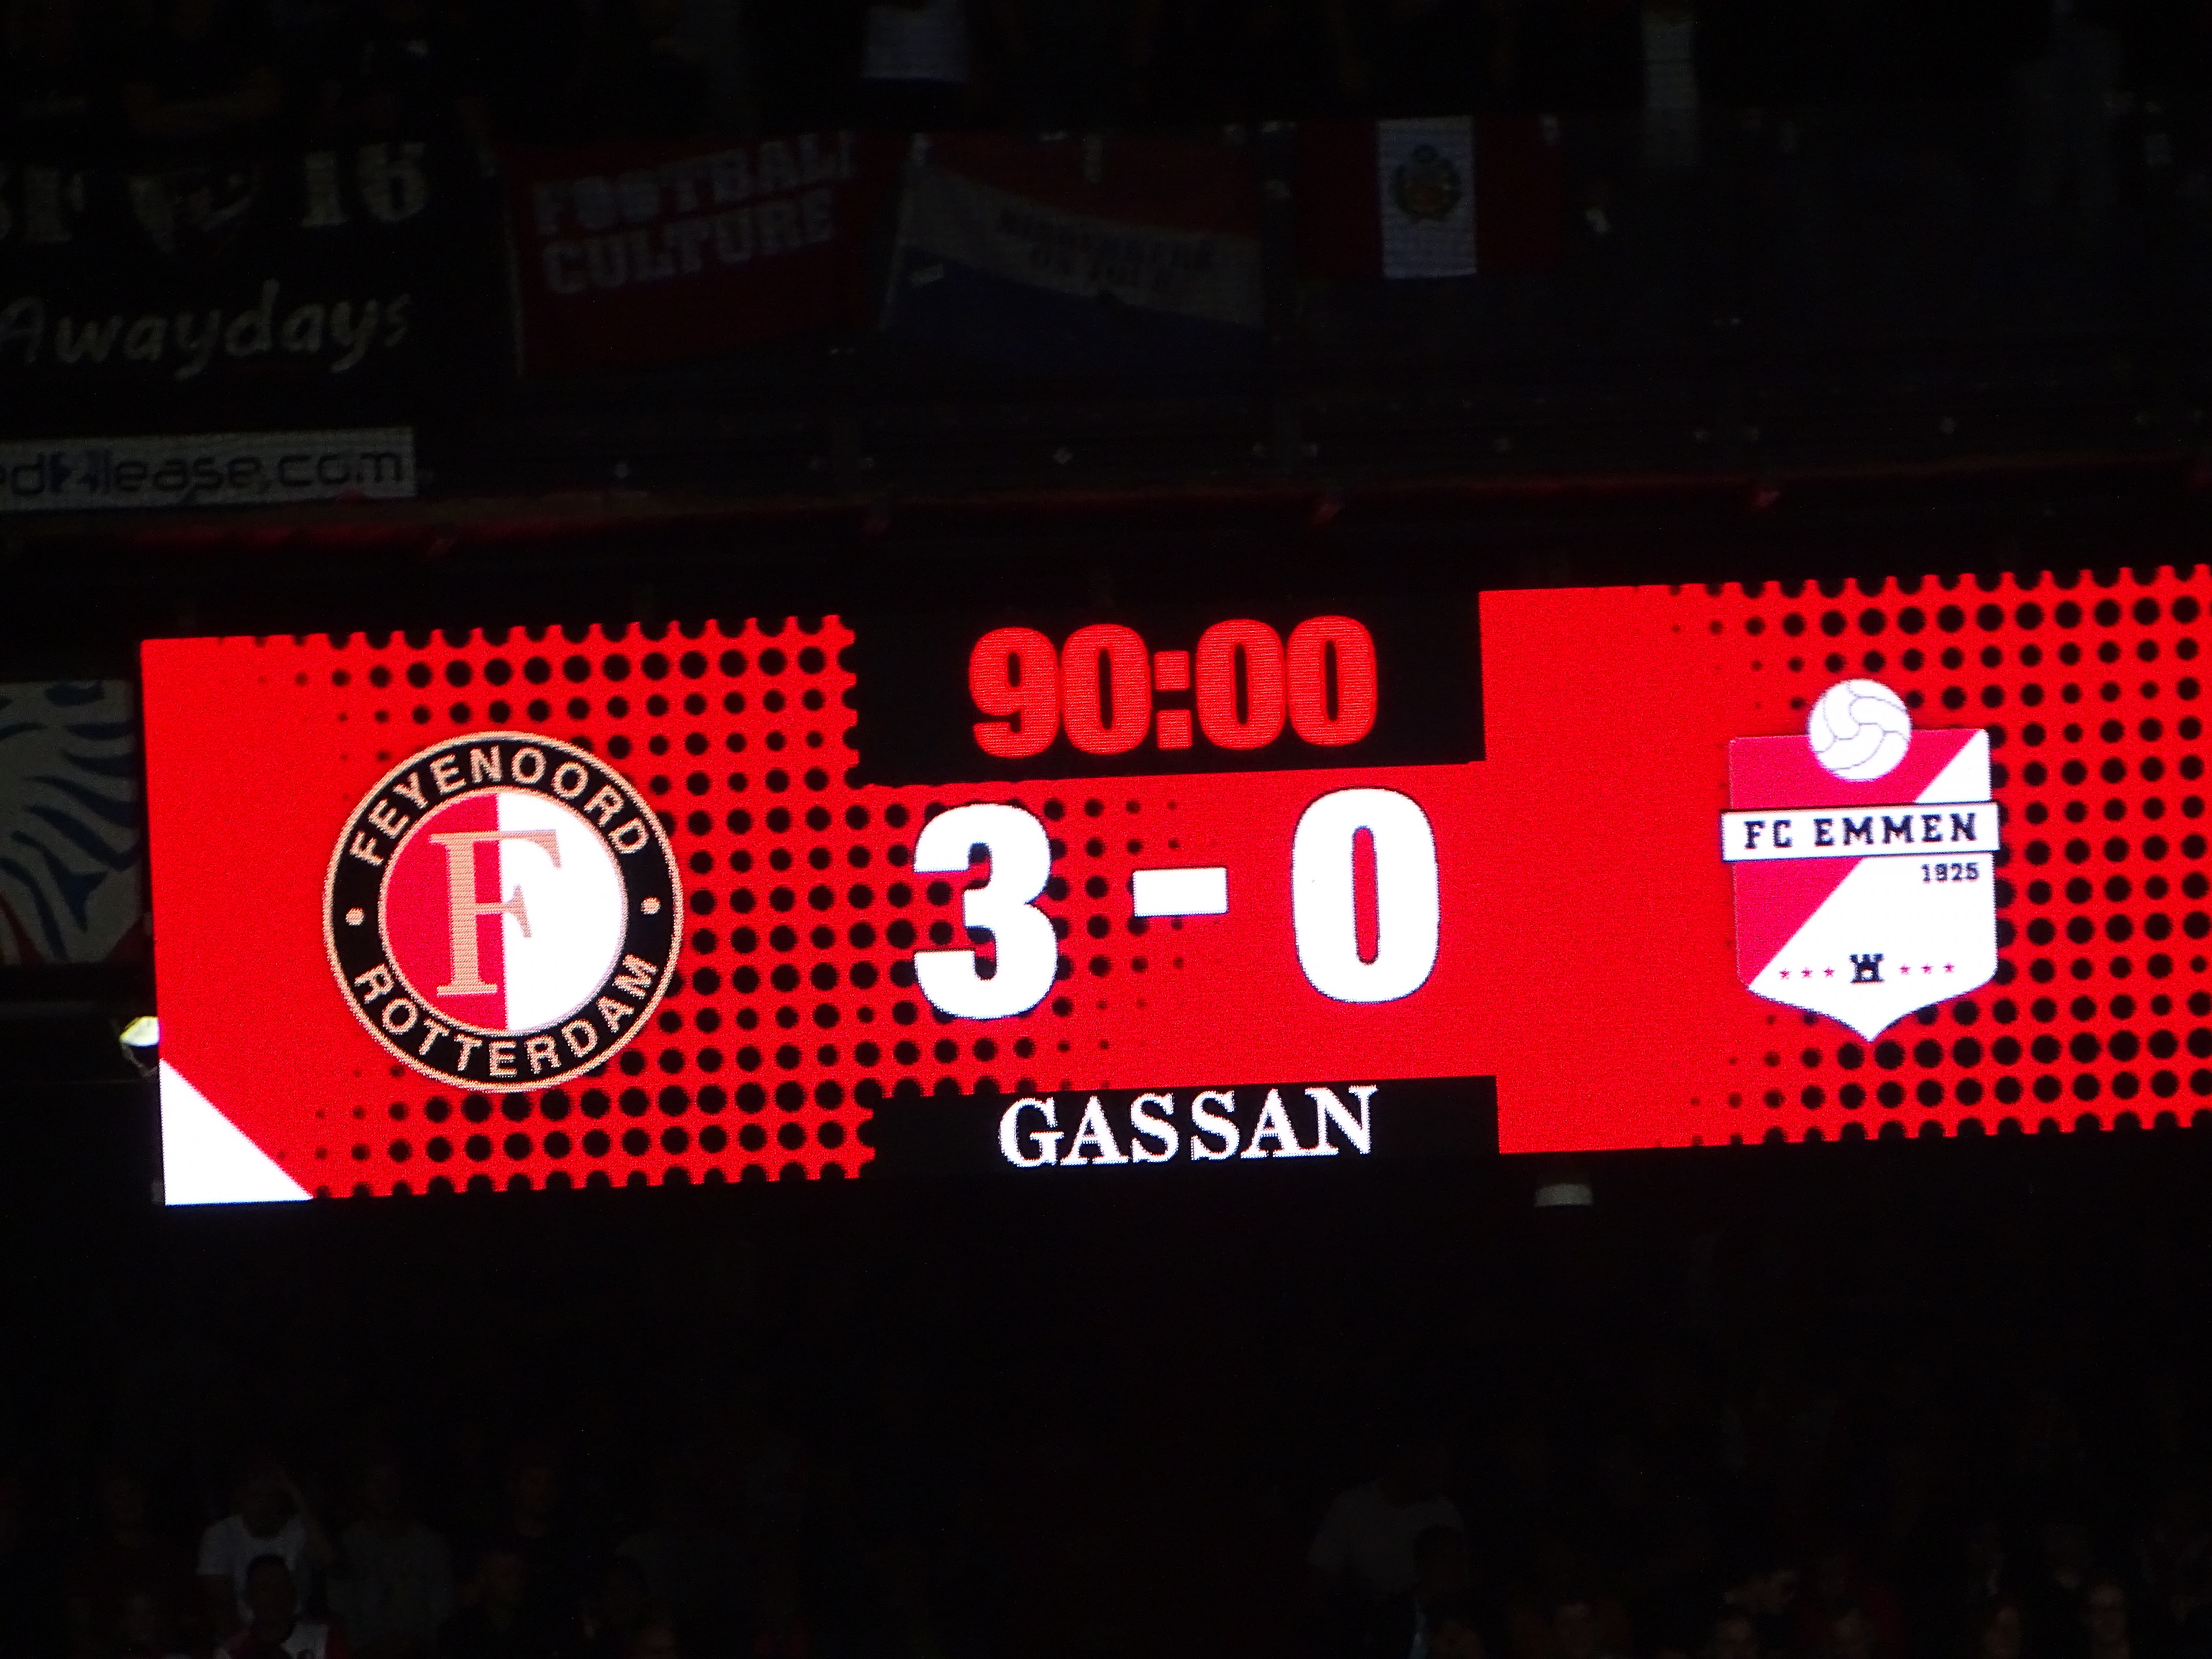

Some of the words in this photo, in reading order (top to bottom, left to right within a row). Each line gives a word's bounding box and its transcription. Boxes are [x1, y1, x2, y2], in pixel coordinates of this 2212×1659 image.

[298, 141, 431, 227] 16
[541, 188, 834, 294] CULTURE
[0, 278, 412, 382] Awaydays
[969, 615, 1377, 758] 90:00
[350, 746, 650, 866] FEYENOORD
[1743, 820, 1793, 849] FC
[1813, 813, 1978, 847] EMMEN
[430, 830, 562, 997] F
[914, 803, 1058, 1018] 3
[1291, 787, 1441, 1003] 0
[1921, 862, 1980, 882] 1925
[354, 954, 659, 1077] ROTTERDAM
[999, 1085, 1378, 1168] GASSAN
